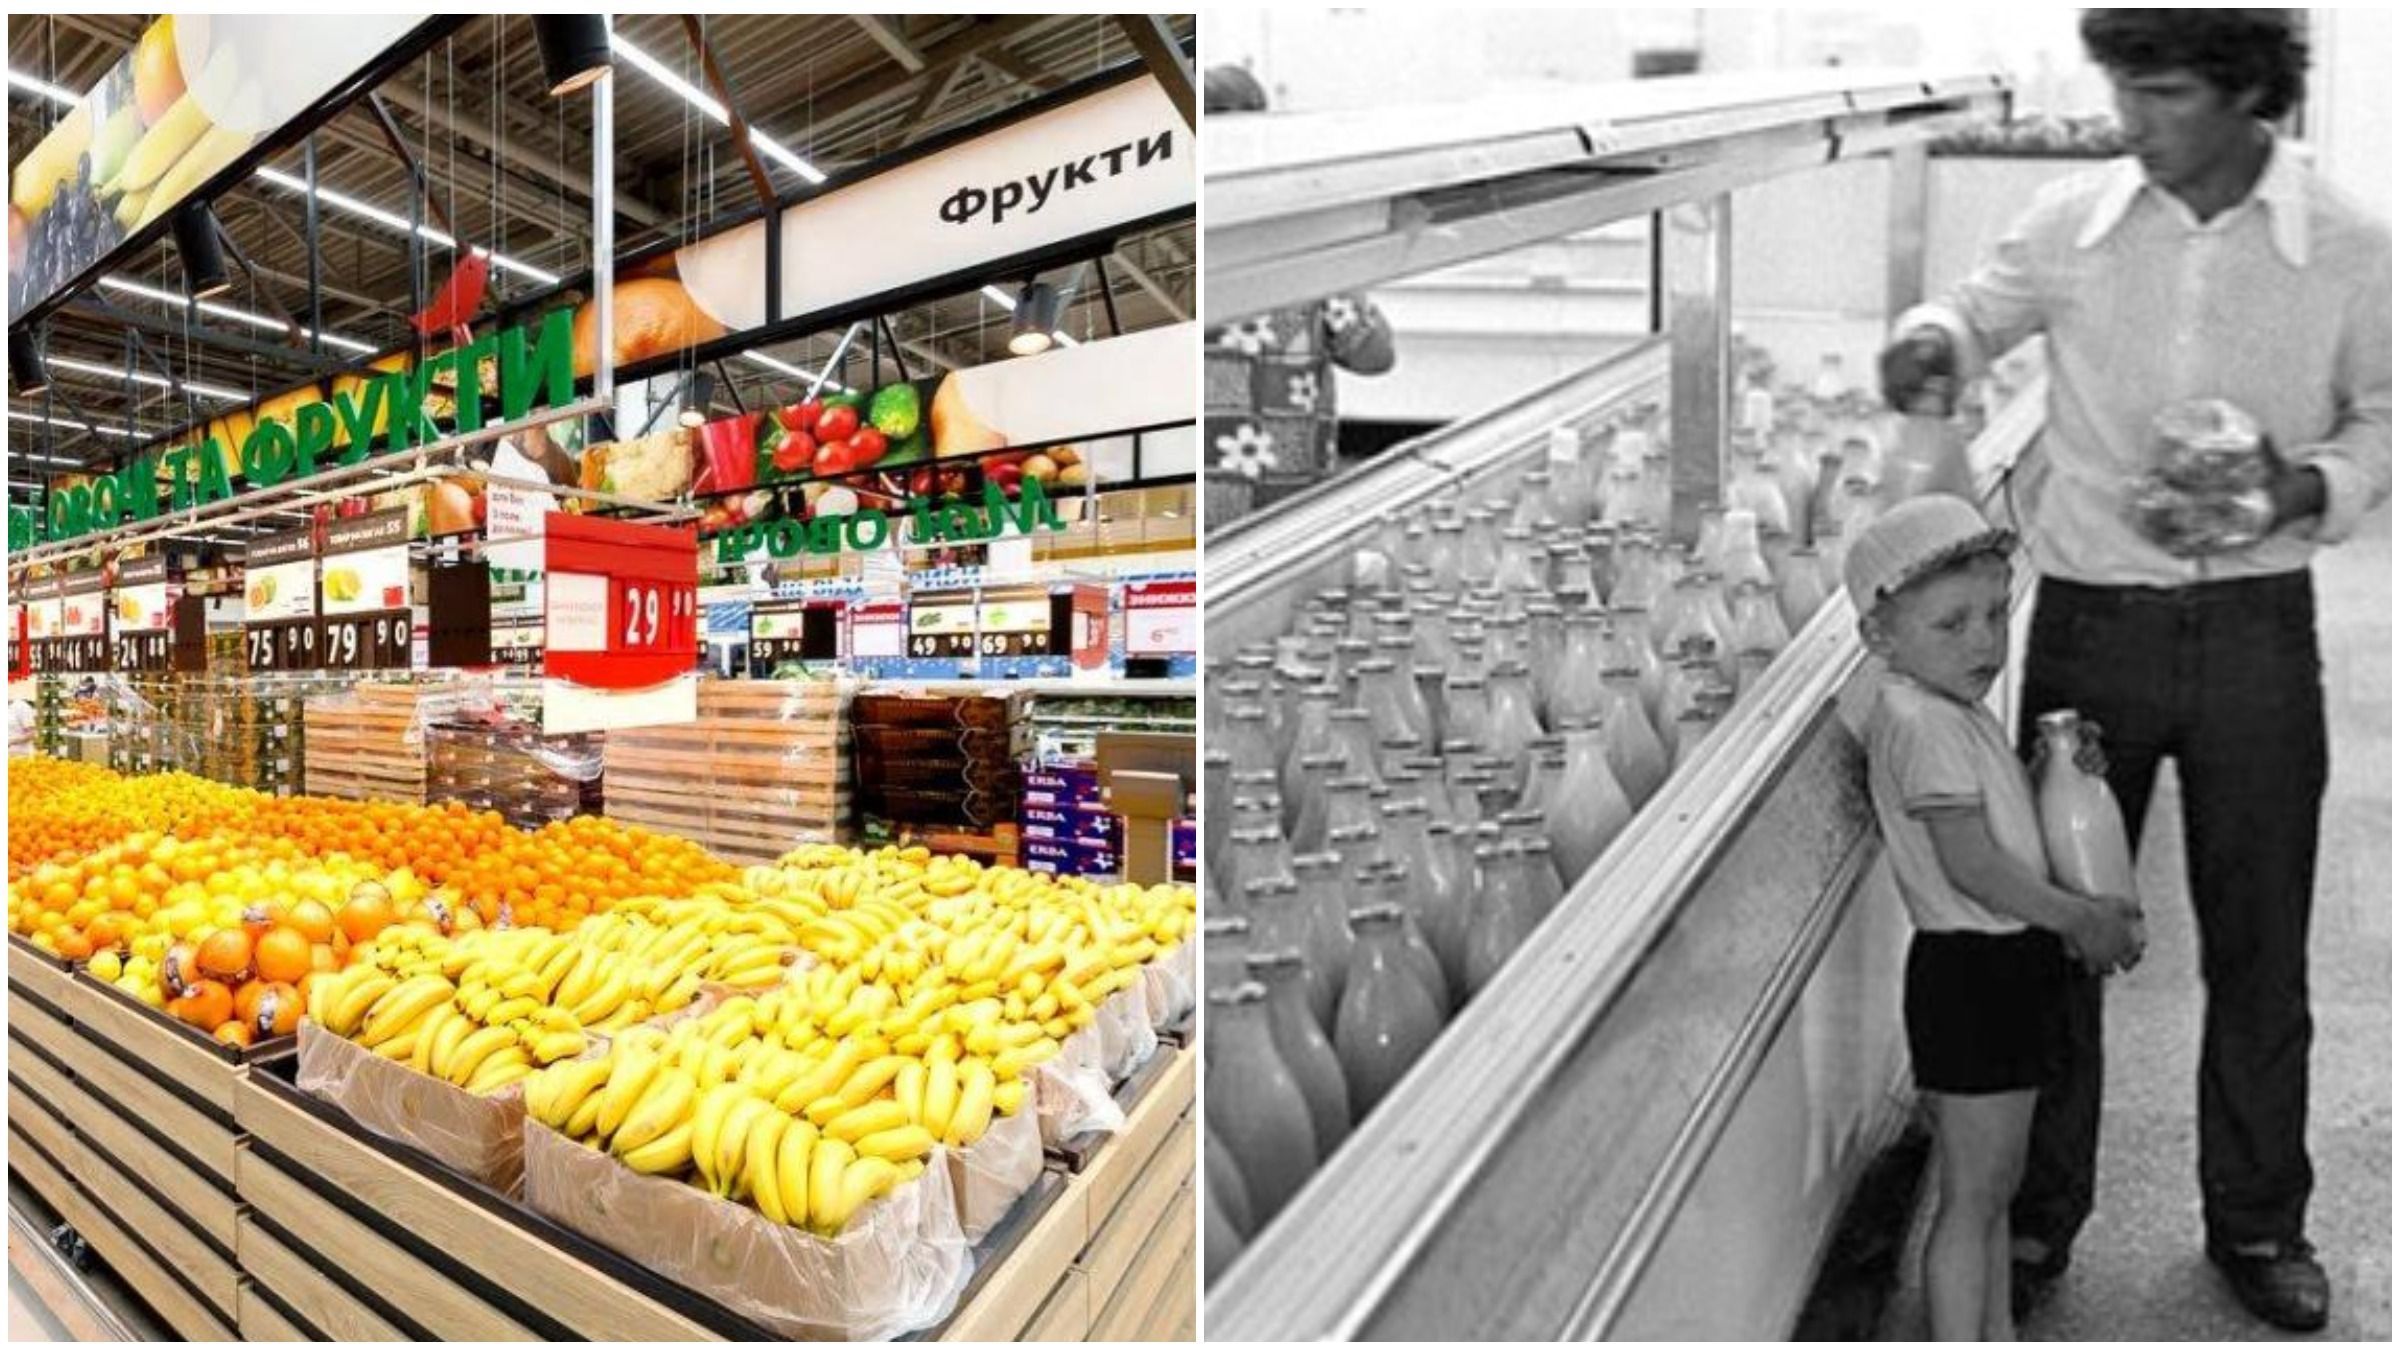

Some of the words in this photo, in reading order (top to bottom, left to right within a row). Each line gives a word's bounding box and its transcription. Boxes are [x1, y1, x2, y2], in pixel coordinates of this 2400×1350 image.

[939, 129, 1173, 225] Фрукти
[165, 437, 233, 511] ТА
[242, 308, 574, 488] ФРУКТИ
[625, 587, 660, 645] 29
[249, 629, 274, 666] 75
[288, 626, 315, 651] 90
[327, 623, 357, 664] 79
[377, 619, 407, 647] 90
[753, 640, 773, 657] 59
[912, 637, 937, 656] 49
[951, 637, 971, 649] 90
[981, 636, 1008, 654] 69
[1022, 634, 1047, 646] 90
